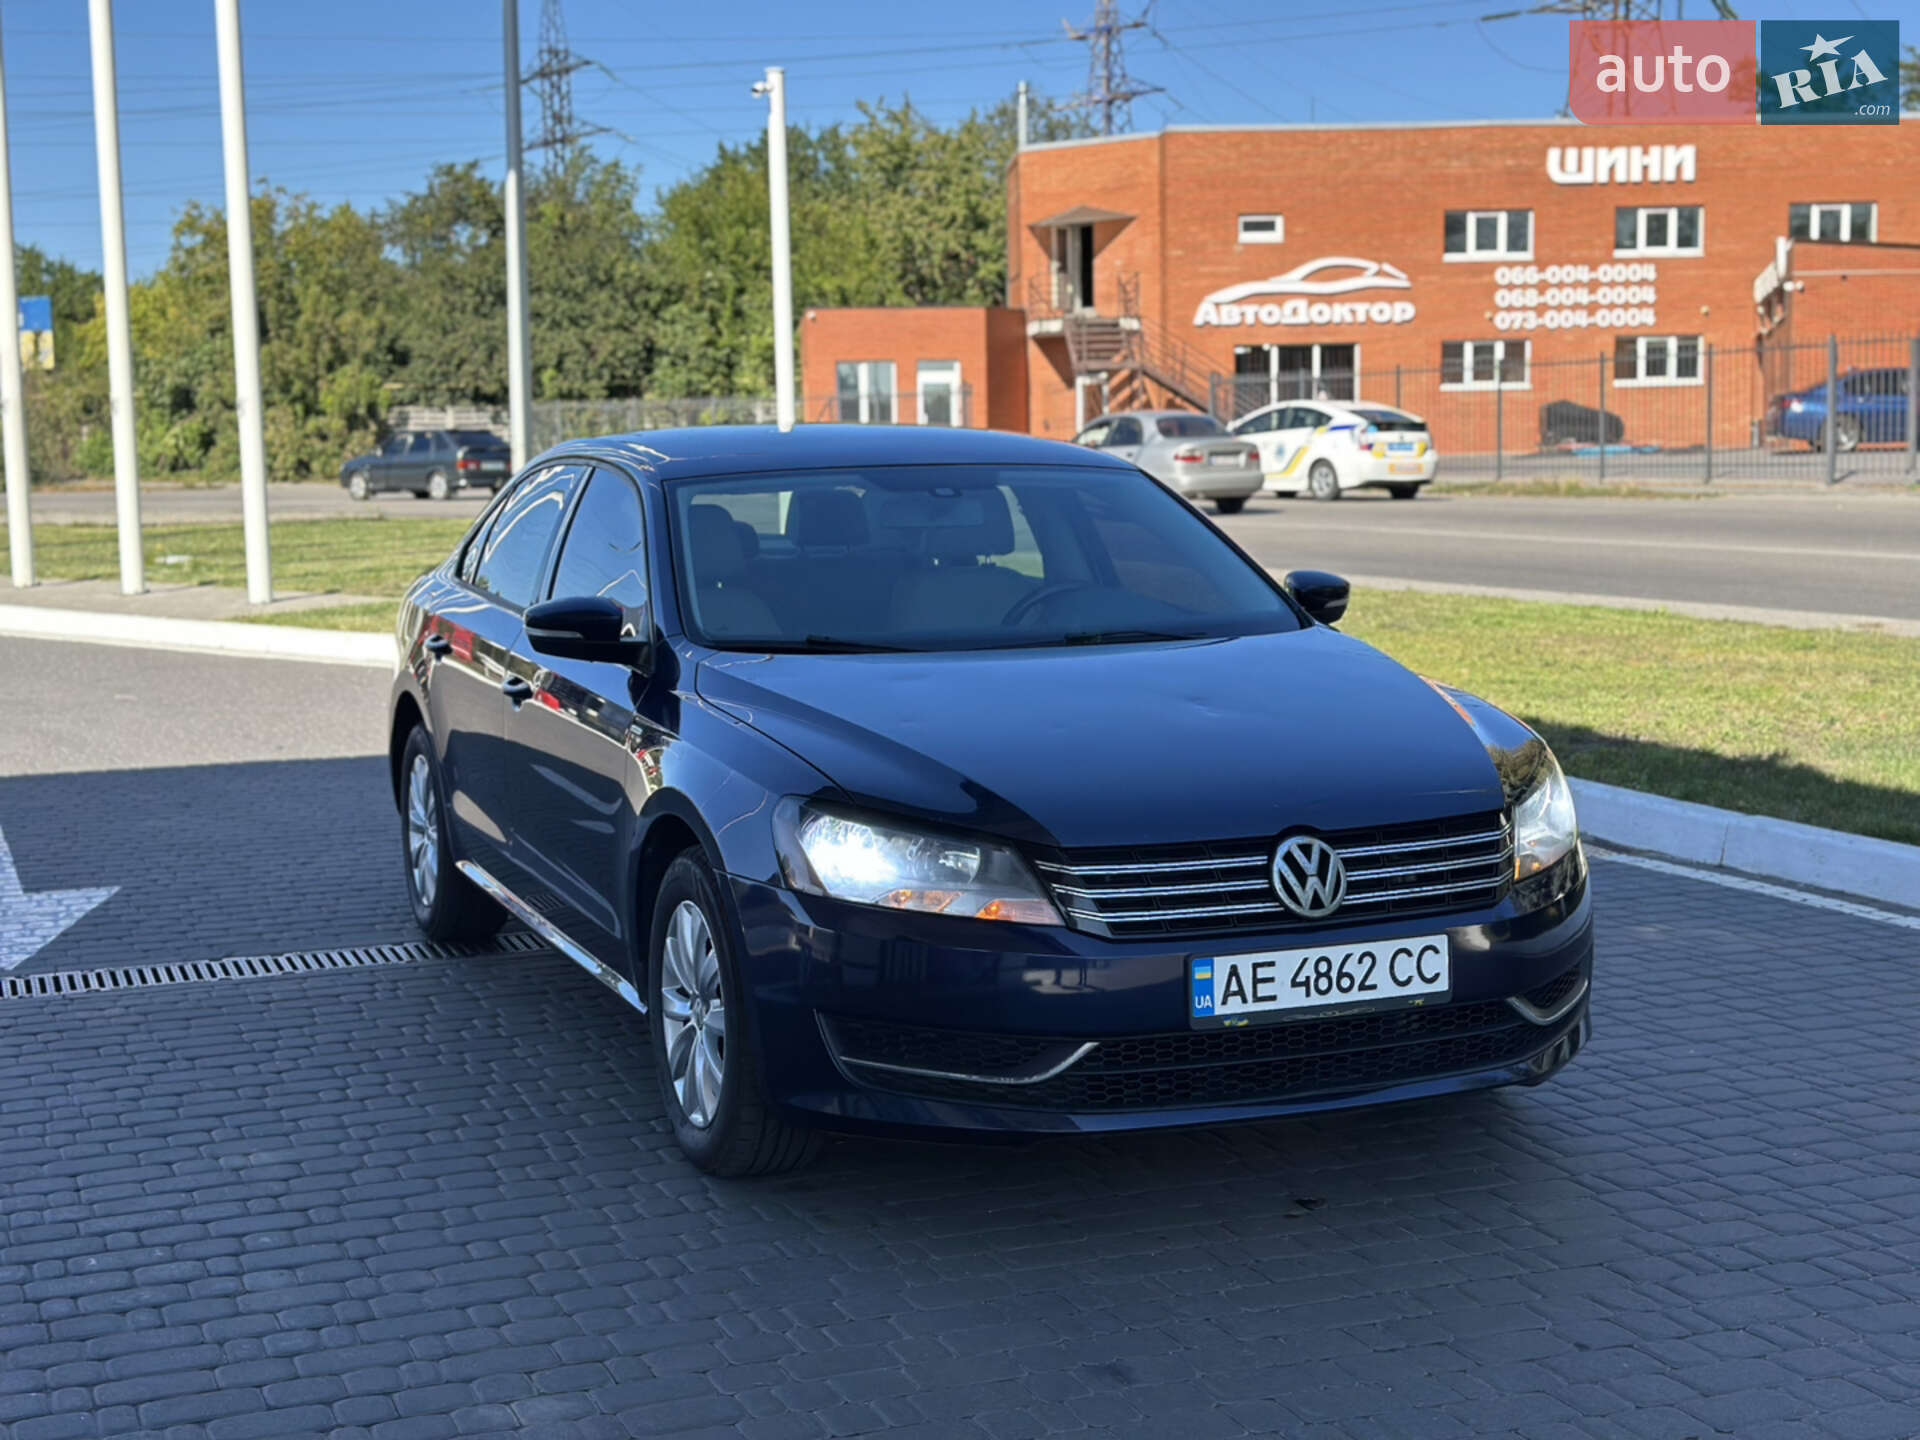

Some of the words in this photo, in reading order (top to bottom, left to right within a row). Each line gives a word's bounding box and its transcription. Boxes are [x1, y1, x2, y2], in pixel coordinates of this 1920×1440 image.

[1546, 144, 1697, 184] ШИНИ
[1494, 263, 1657, 286] 066-004-0004
[1494, 285, 1657, 308] 068-004-0004
[1493, 307, 1656, 331] 073-004-0004
[1220, 960, 1278, 1006] AE
[1290, 950, 1378, 998] 4862
[1389, 944, 1441, 988] CC
[1194, 995, 1213, 1010] UA
